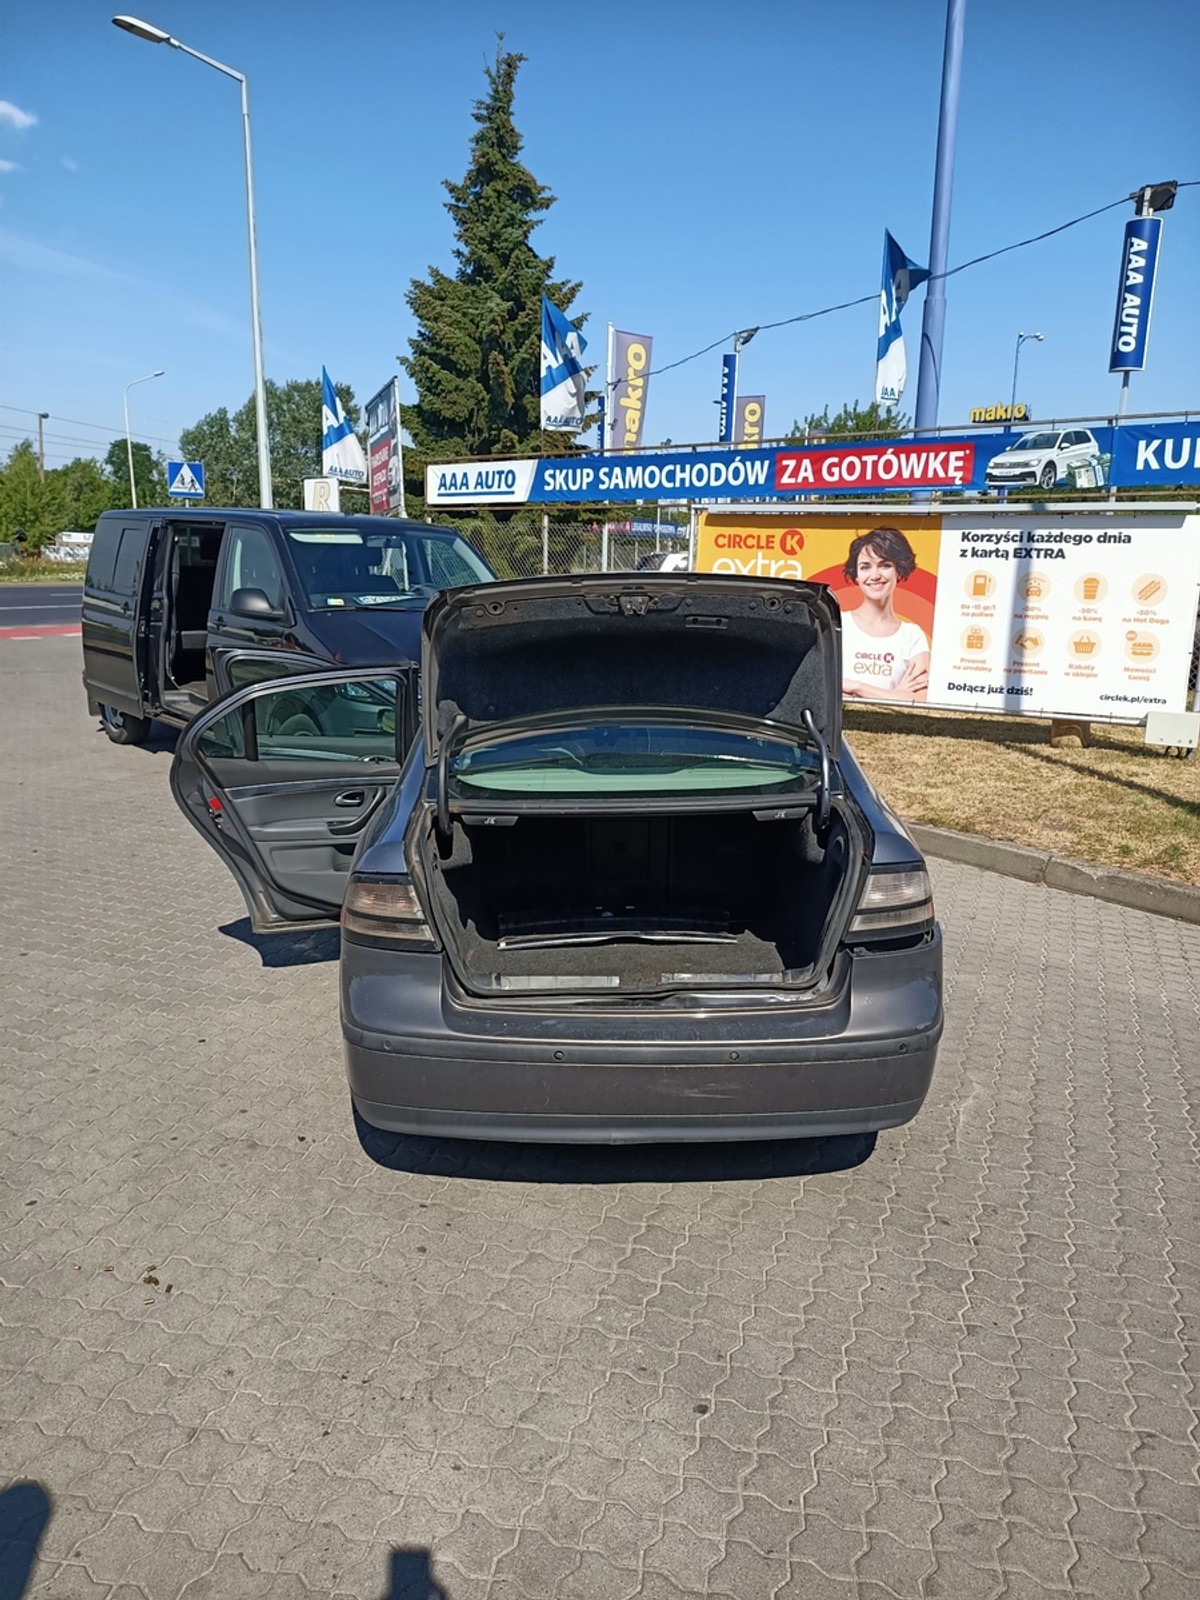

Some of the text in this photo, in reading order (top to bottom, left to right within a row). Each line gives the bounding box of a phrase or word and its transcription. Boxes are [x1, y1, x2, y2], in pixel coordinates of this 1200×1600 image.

[1118, 236, 1149, 354] AAA AUTO
[344, 468, 364, 479] AUTO
[438, 469, 516, 491] AAA AUTO
[544, 468, 595, 492] SKUP
[599, 456, 770, 490] SAMOCHODÓW
[780, 459, 815, 484] ZA
[714, 533, 775, 550] CIRCLE
[961, 531, 1132, 546] Korzyści każdego dnia
[959, 547, 1066, 560] z kartą EXTRA
[855, 651, 881, 661] CIRCLE
[854, 660, 893, 677] extra
[947, 682, 1034, 697] Dołącz już dziś!
[1099, 693, 1167, 705] circlek.pl/extra
